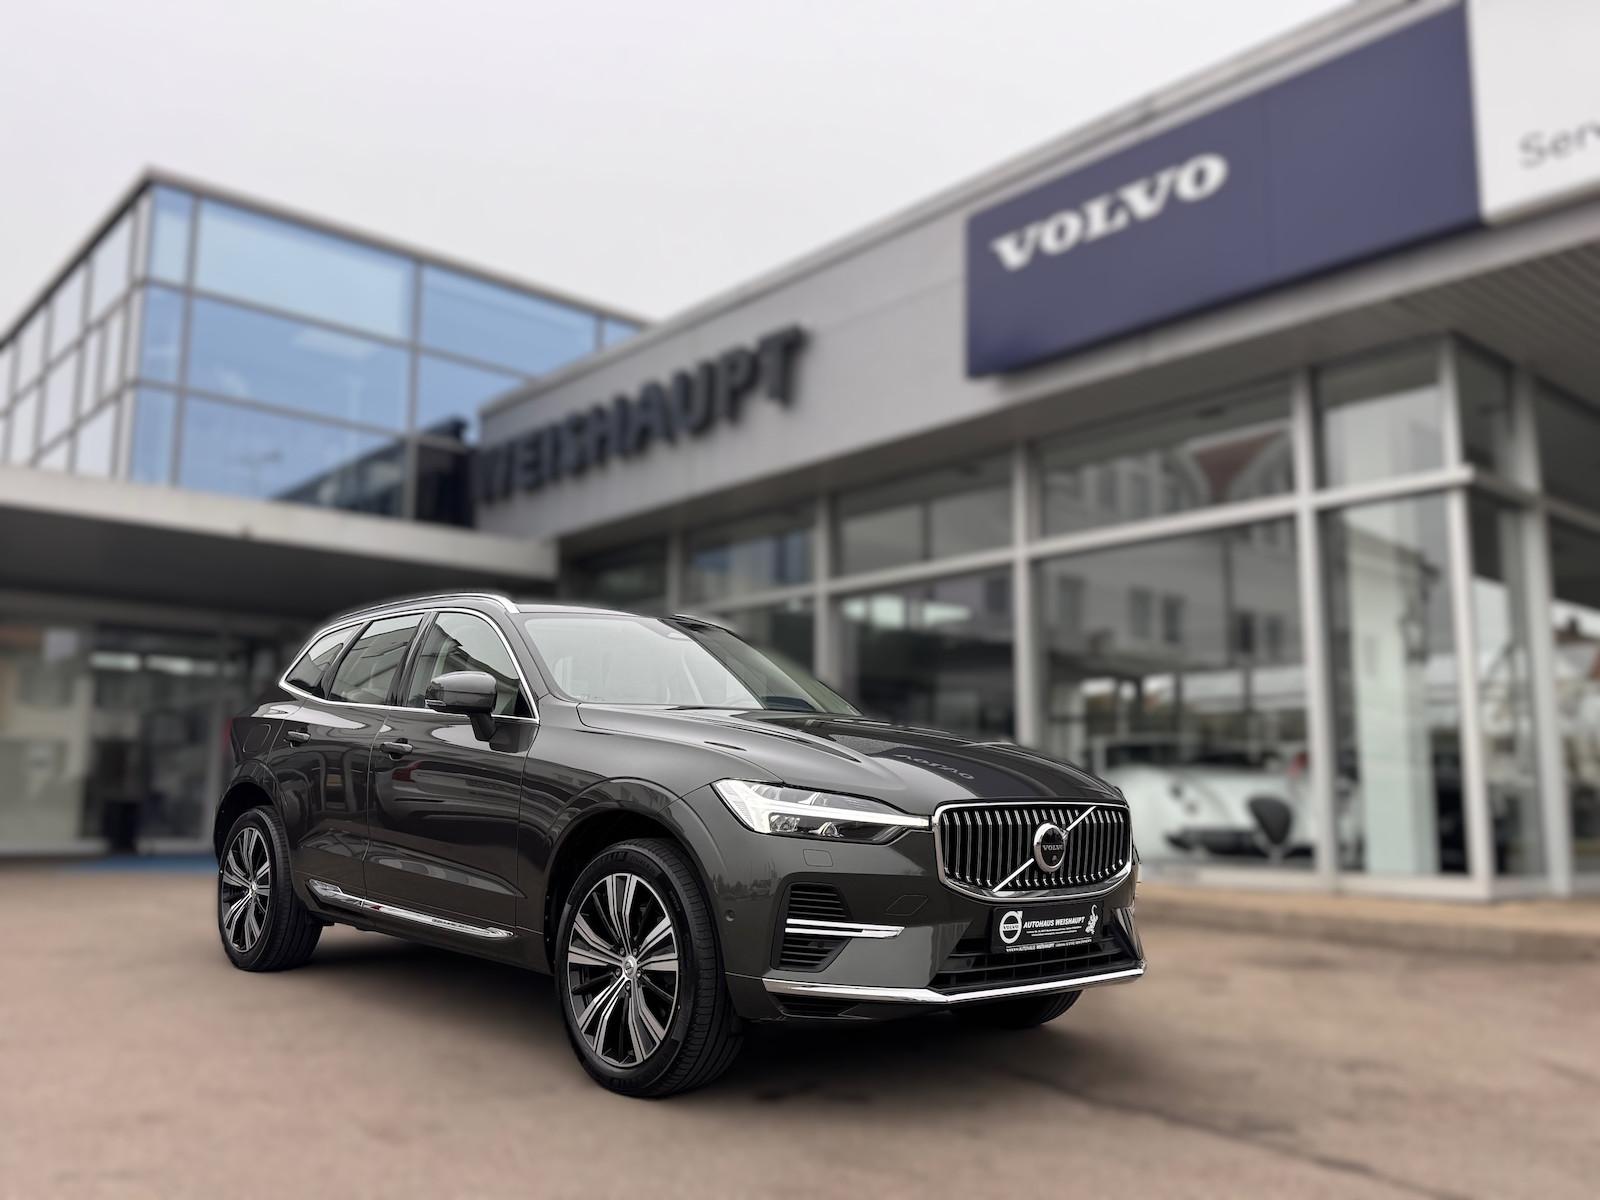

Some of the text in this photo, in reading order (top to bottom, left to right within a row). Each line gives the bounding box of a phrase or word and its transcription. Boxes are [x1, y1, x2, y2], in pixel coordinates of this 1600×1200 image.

[1518, 117, 1600, 170] Ser
[989, 152, 1230, 271] VOLVO
[1023, 919, 1054, 929] AUTOHAUS
[1055, 916, 1085, 926] WEISHAUPT
